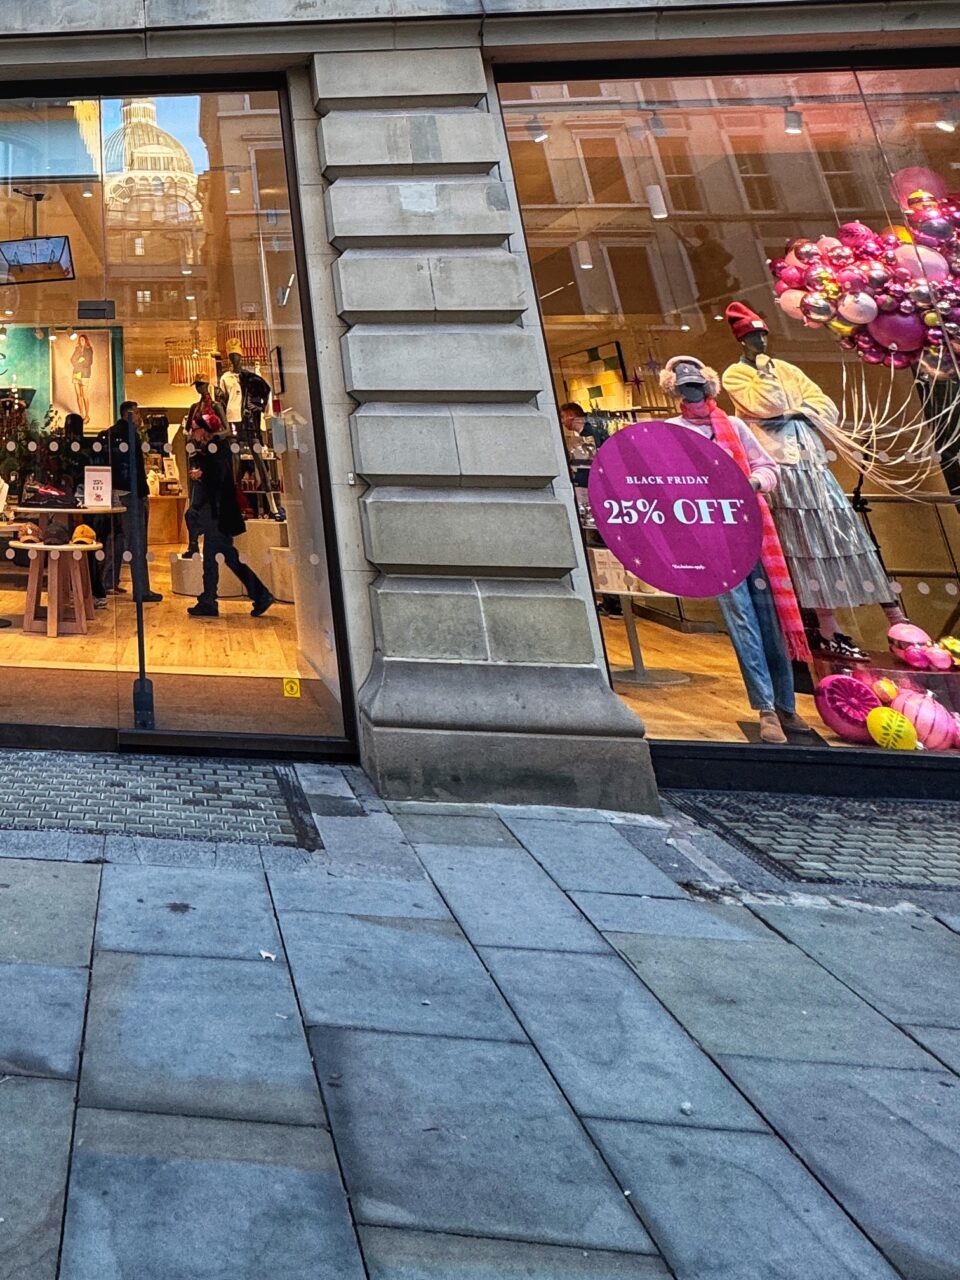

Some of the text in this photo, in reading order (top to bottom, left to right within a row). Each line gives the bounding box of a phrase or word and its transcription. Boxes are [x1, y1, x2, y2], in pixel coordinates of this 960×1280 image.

[625, 475, 710, 486] BLACK FRIDAY
[603, 498, 666, 525] 25%
